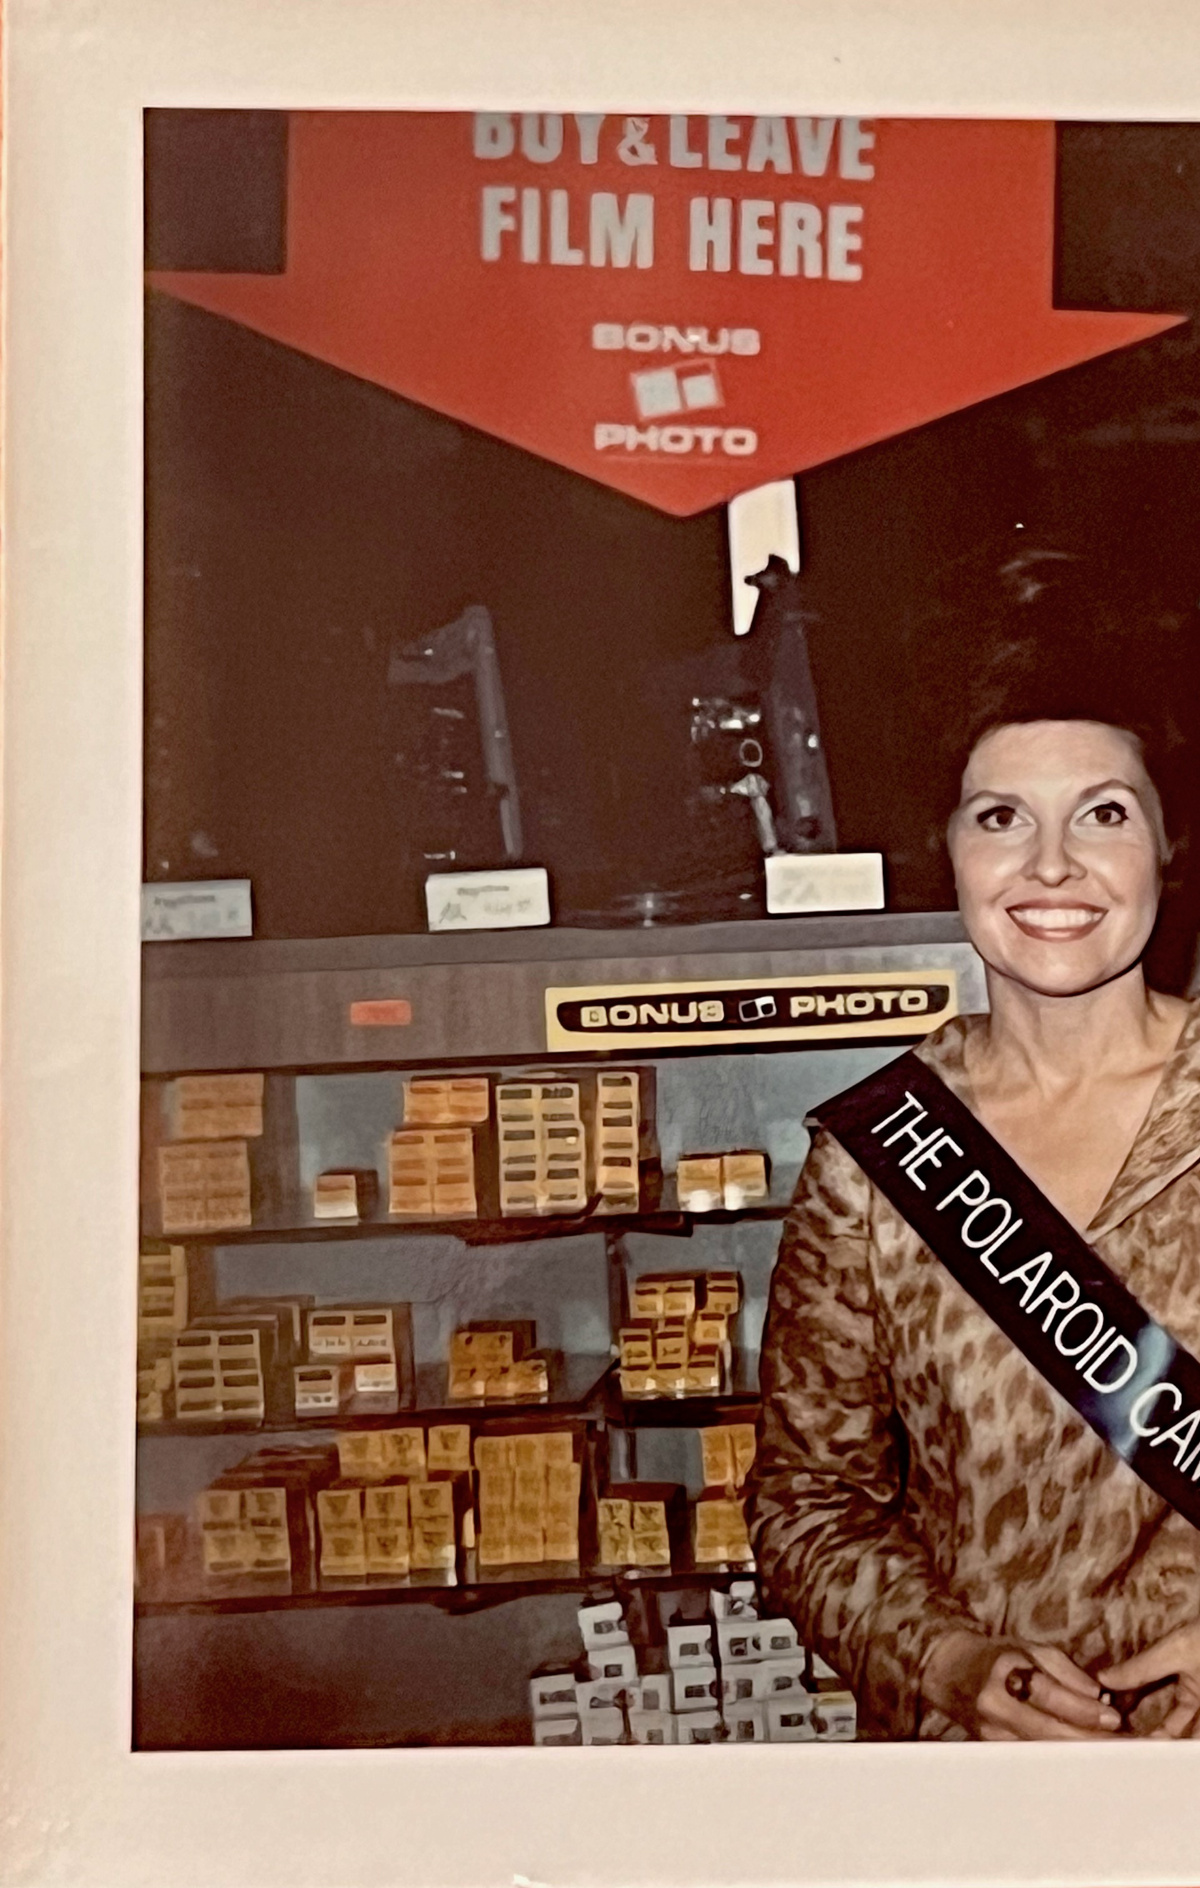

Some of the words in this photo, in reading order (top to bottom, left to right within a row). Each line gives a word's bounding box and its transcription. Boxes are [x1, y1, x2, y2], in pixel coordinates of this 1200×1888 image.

[480, 186, 655, 269] FILM
[689, 197, 864, 282] HERE
[592, 322, 761, 356] BONUS
[594, 423, 758, 456] PHOTO
[580, 1000, 725, 1028] BONUS
[789, 989, 929, 1019] PHOTO
[871, 1091, 964, 1191] THE
[936, 1170, 1139, 1394] POLAROID
